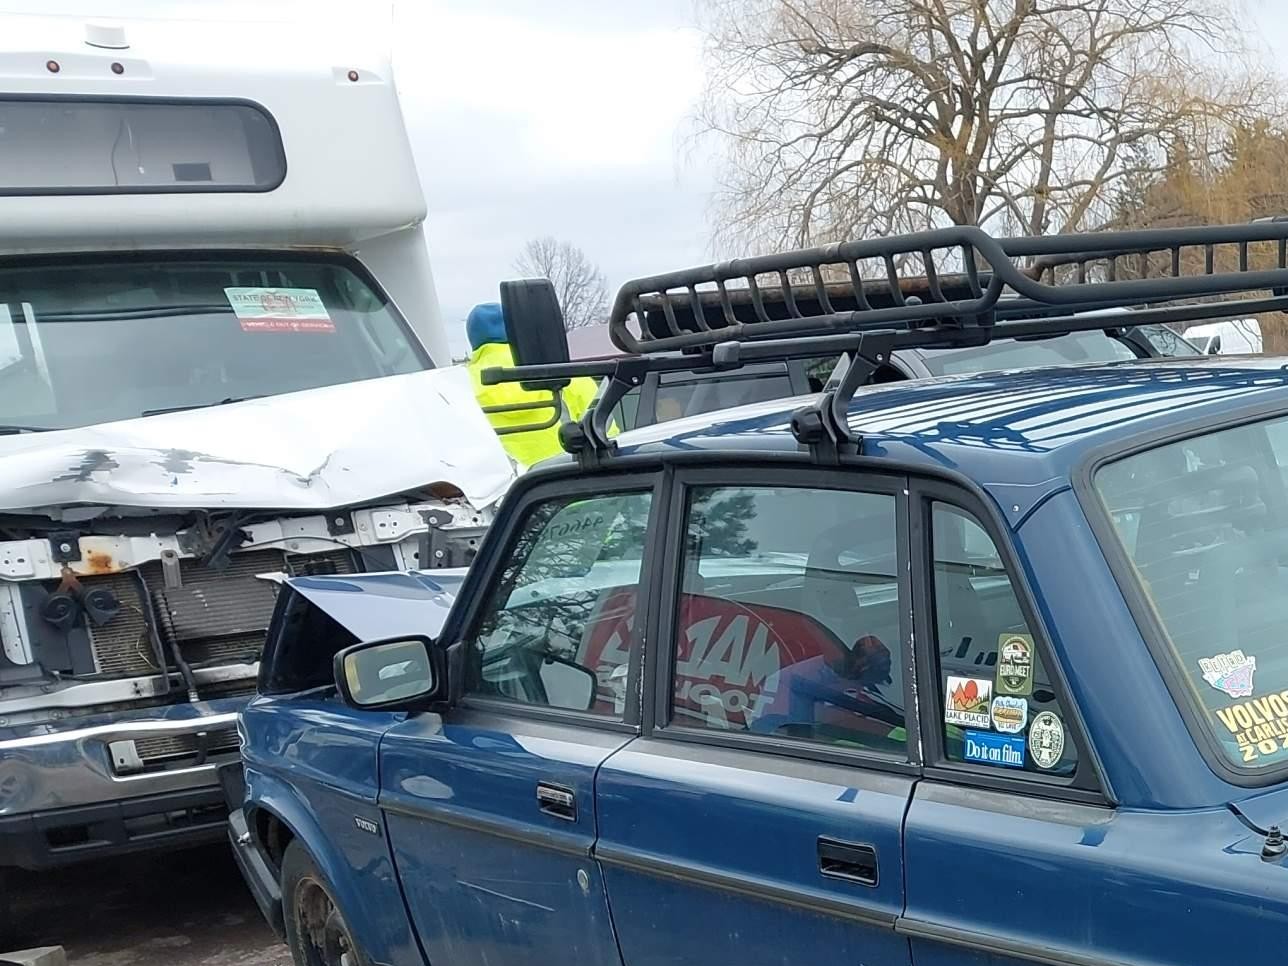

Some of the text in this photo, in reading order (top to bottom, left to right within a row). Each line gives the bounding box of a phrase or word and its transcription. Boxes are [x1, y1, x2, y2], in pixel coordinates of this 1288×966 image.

[946, 711, 962, 721] LAKE
[964, 713, 989, 724] PLACID
[966, 739, 981, 758] Do
[981, 742, 988, 759] it
[988, 747, 1001, 761] on
